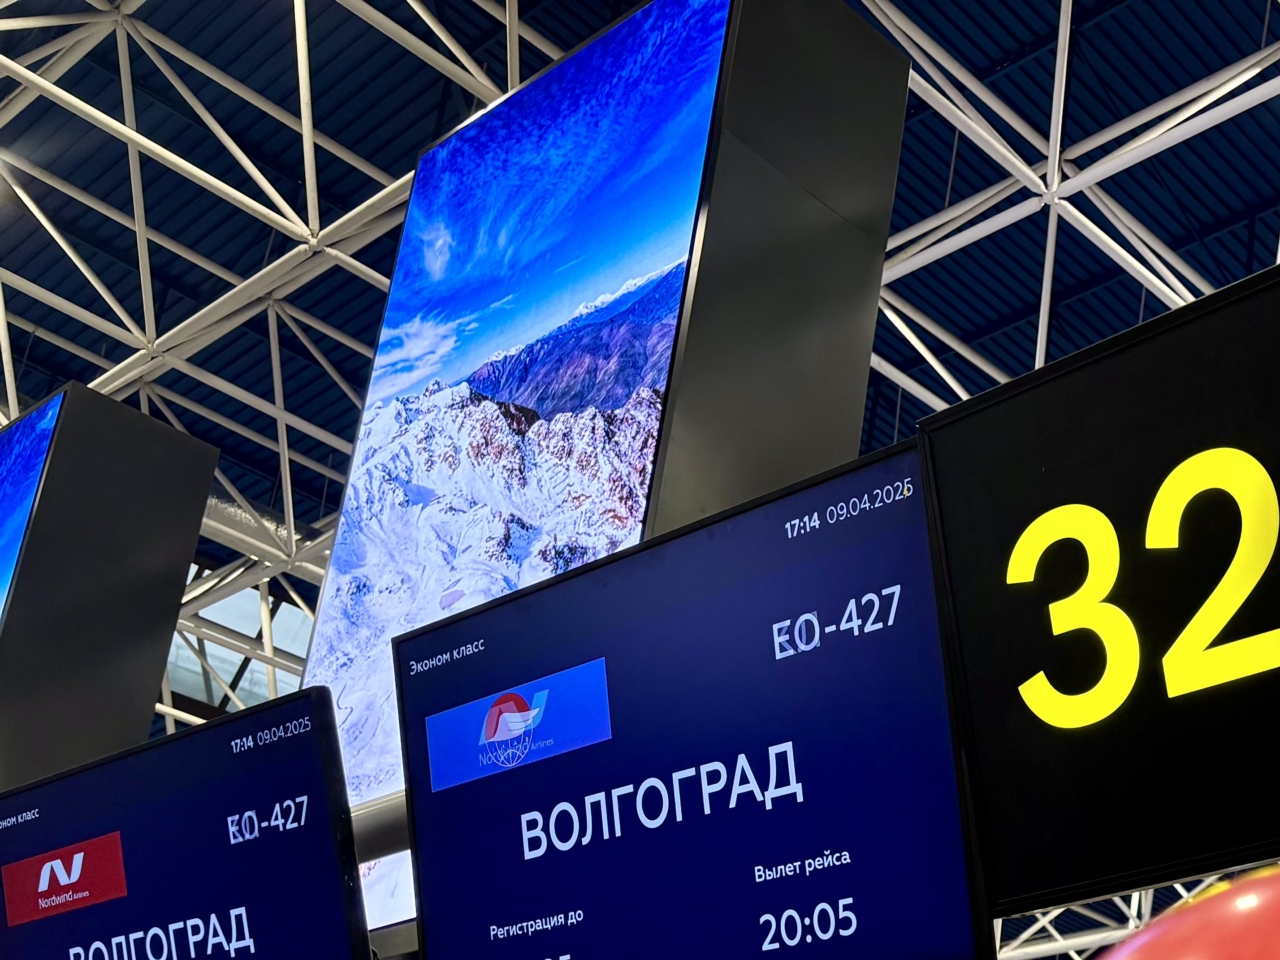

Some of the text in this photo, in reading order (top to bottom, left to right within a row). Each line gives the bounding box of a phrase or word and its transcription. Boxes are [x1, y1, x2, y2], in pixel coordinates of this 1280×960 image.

[785, 478, 913, 538] 17:14 09.04.2025
[410, 639, 485, 675] Эконом класс
[231, 717, 311, 753] 17:14 09.04.2025
[531, 738, 554, 751] Airlines
[18, 808, 39, 823] класс
[520, 741, 803, 860] ВОЛГОГРАД
[755, 850, 851, 882] Вылет рейса
[38, 890, 73, 909] Nordwind
[490, 910, 584, 940] Регистрация до
[760, 898, 857, 951] 20:05
